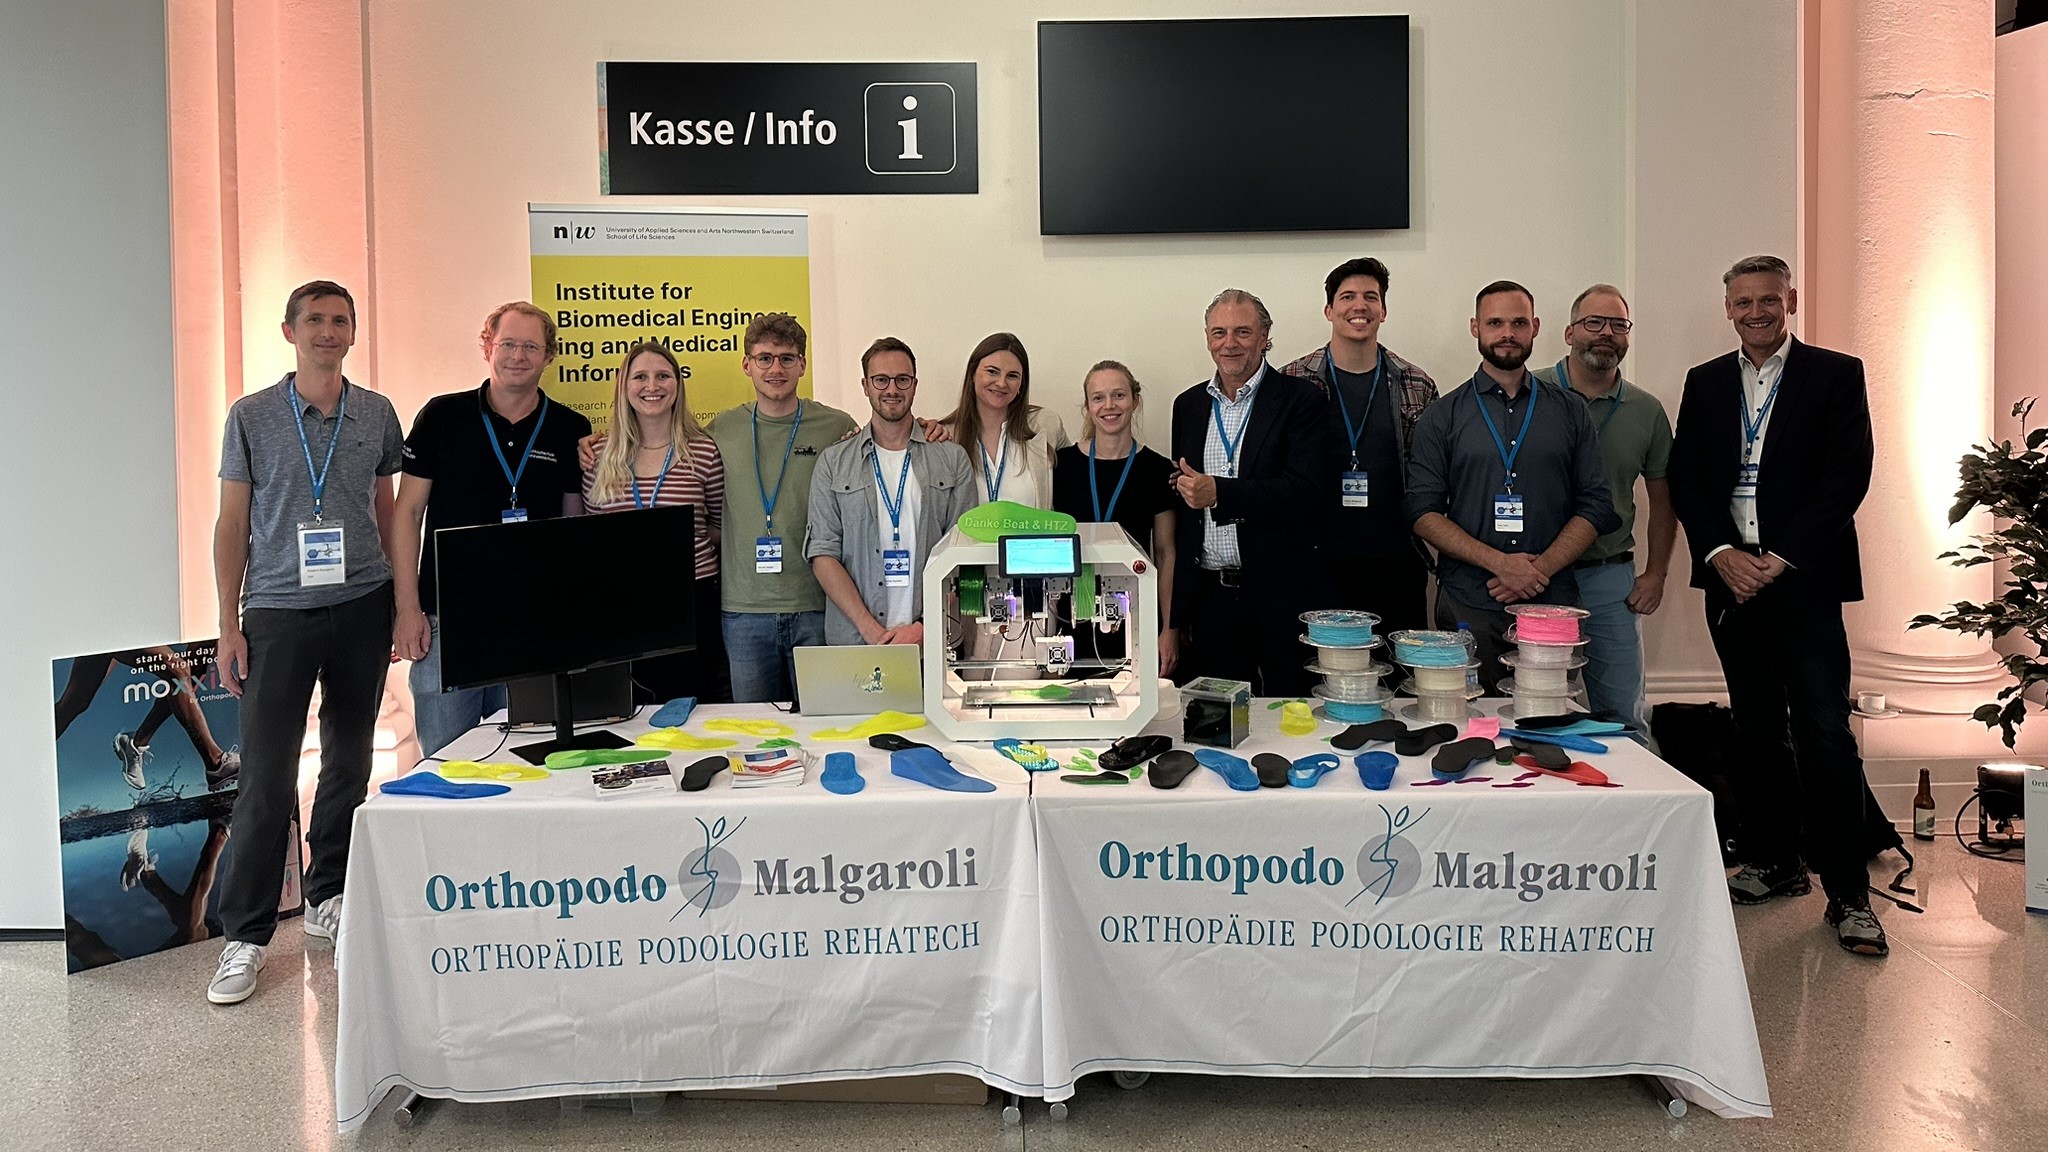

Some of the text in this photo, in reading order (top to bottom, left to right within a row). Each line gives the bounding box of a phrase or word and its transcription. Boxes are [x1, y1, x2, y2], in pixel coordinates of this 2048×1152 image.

[629, 111, 734, 145] Kasse
[766, 110, 837, 146] Info
[556, 282, 692, 301] Institute for
[557, 308, 685, 328] Biomedical
[558, 337, 594, 359] ing
[965, 517, 1069, 531] Danke Beat & HTZ
[130, 666, 144, 675] on
[148, 662, 167, 673] the
[171, 658, 198, 670] right
[136, 647, 215, 665] start your day
[123, 666, 225, 704] moxxi
[425, 847, 979, 919] Orthopodo Malgaroli
[1099, 840, 1658, 903] Orthopodo Malgaroli
[431, 920, 980, 975] ORTHOPÄDIE PODOLOGIE REHATECH
[1100, 914, 1655, 953] ORTHOPÄDIE PODOLOGIE REHATECH
